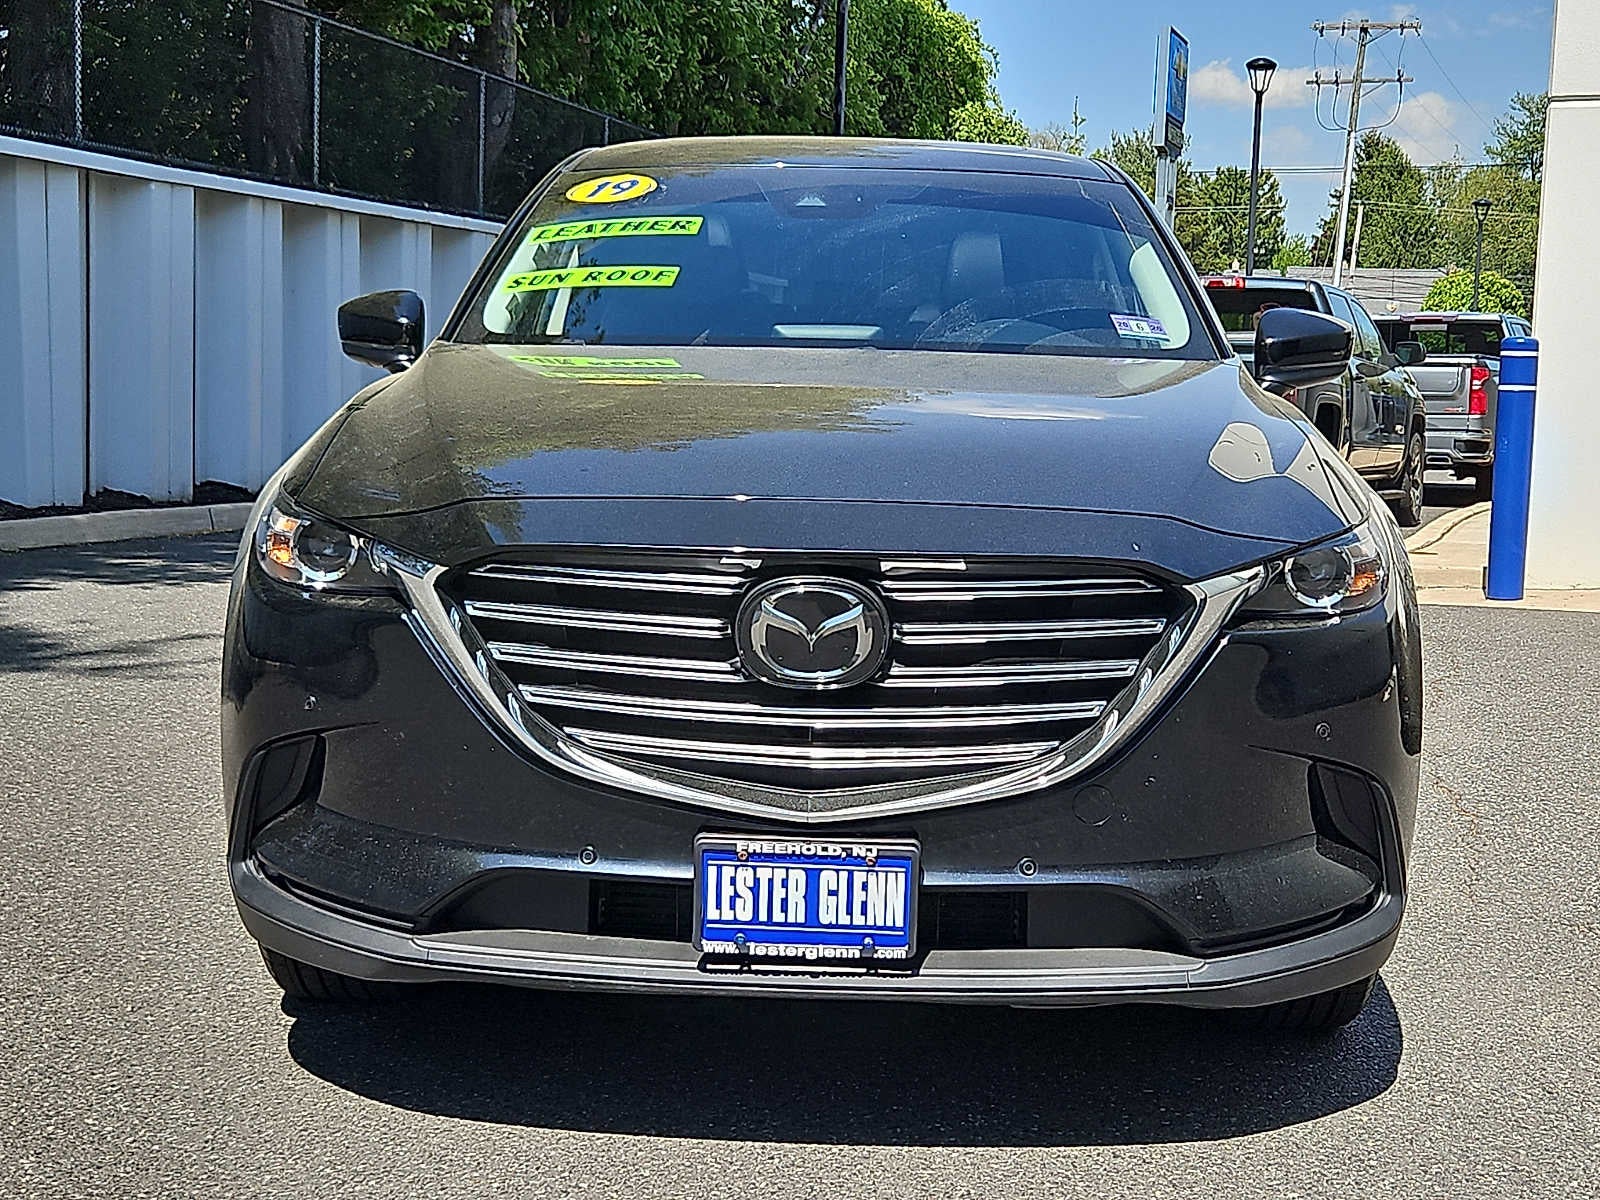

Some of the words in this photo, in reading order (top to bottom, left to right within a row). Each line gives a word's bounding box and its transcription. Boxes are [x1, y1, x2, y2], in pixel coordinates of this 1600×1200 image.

[586, 179, 640, 198] 19
[533, 219, 694, 242] LEATHER
[507, 272, 573, 289] SUN
[582, 269, 677, 284] ROOF
[736, 840, 847, 858] FREEHOLD,
[852, 846, 878, 858] NJ
[706, 865, 806, 924] LESTER
[819, 870, 906, 928] GLENN
